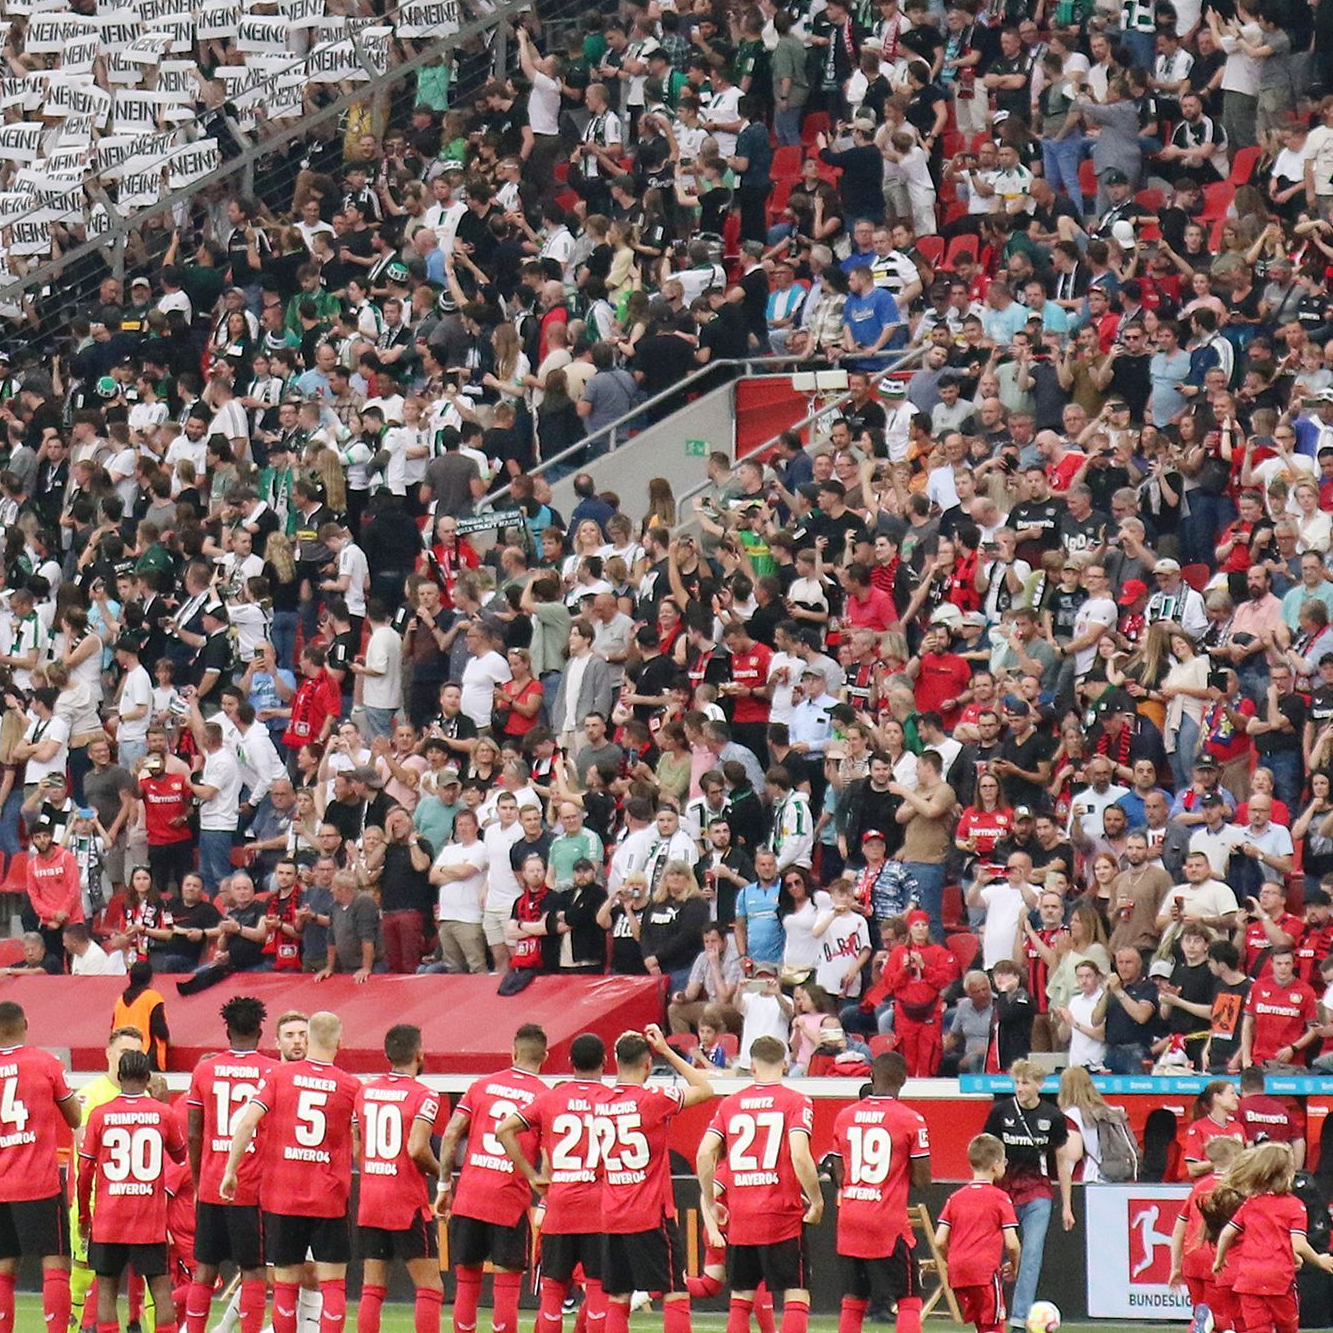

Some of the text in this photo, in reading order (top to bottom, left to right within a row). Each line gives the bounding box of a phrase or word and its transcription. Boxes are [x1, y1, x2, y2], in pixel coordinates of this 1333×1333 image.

[239, 23, 284, 43] NEIN!
[1255, 1002, 1300, 1017] Barmenia
[214, 1065, 260, 1079] TAPSOBA
[293, 1075, 337, 1092] BAKKER
[0, 1077, 29, 1131] 4
[594, 1101, 638, 1117] PALACIOS
[740, 1096, 775, 1110] WIRTZ
[104, 1113, 160, 1125] FRIMPONG
[295, 1090, 328, 1147] 5
[854, 1110, 886, 1124] DIABY
[363, 1102, 403, 1160] 10
[728, 1111, 785, 1171] 27
[595, 1113, 651, 1171] 25
[102, 1127, 164, 1182] 30
[846, 1126, 893, 1186] 19
